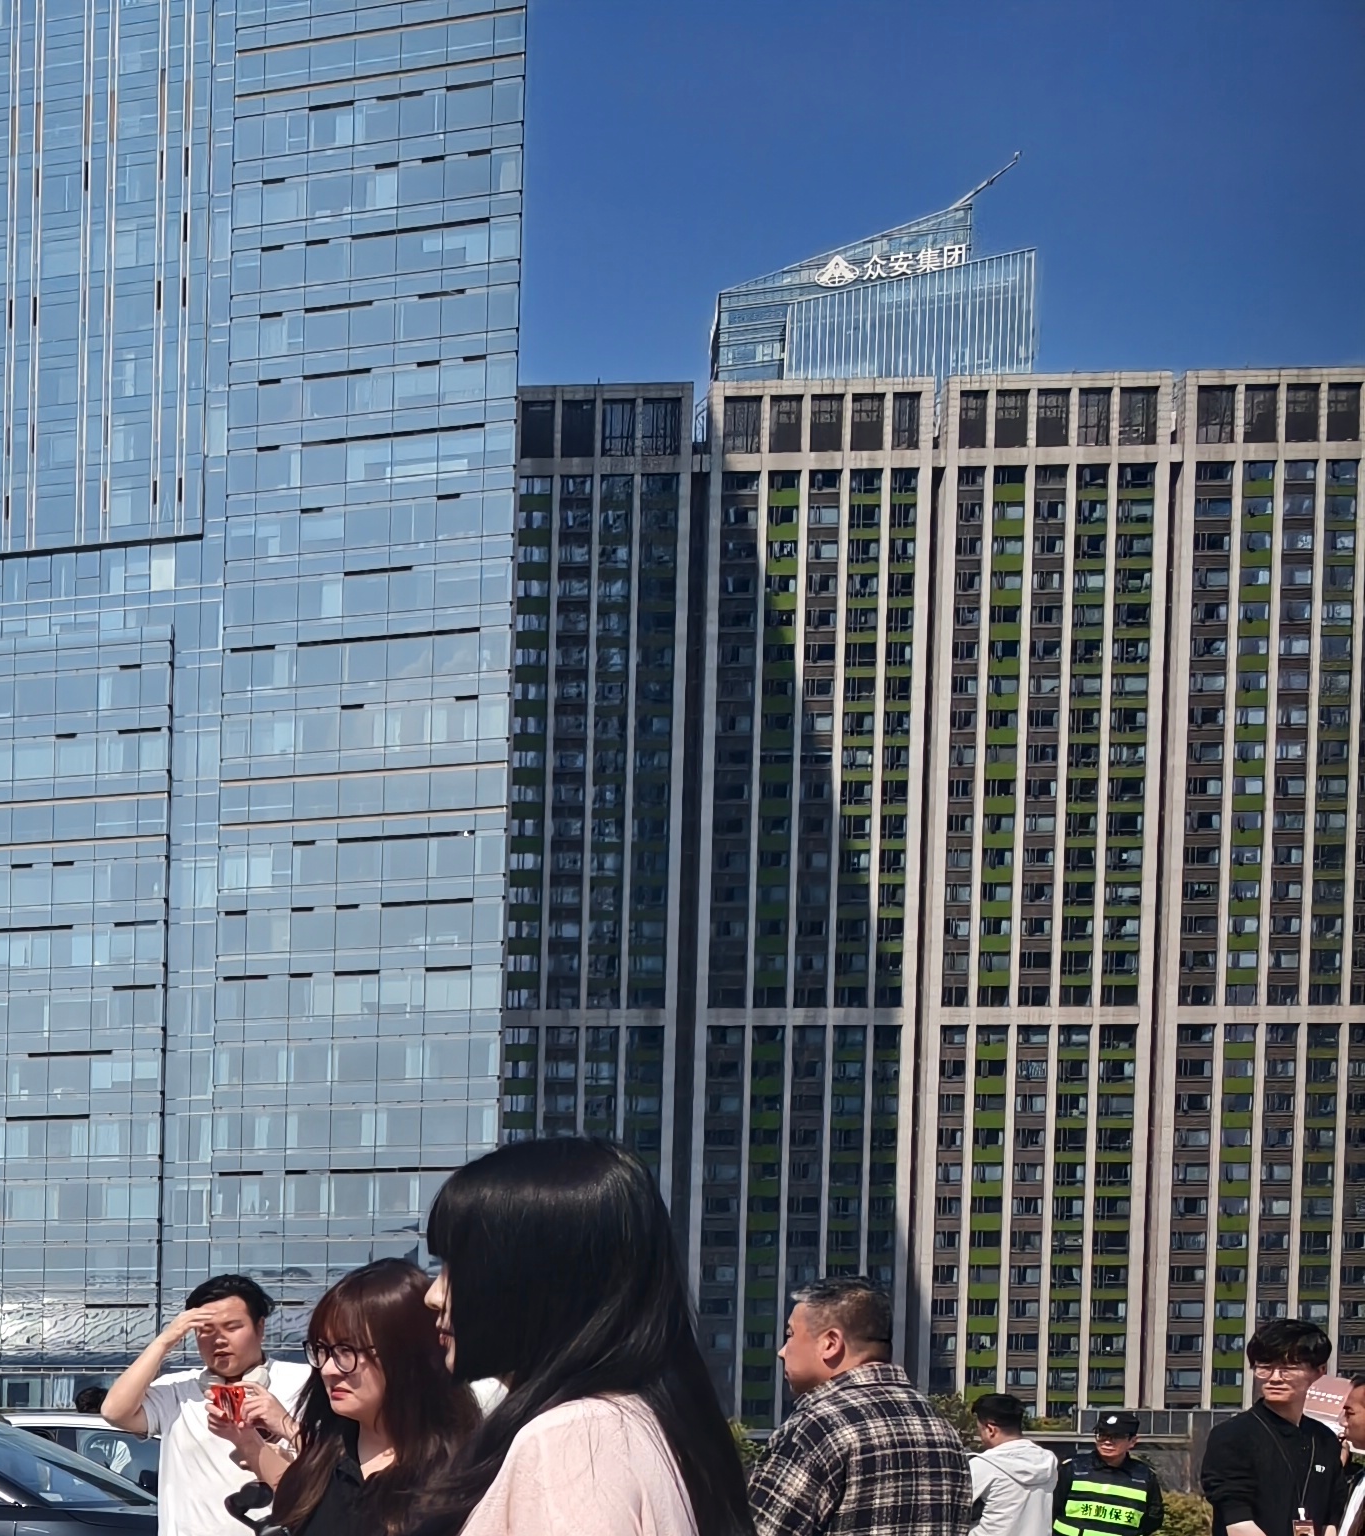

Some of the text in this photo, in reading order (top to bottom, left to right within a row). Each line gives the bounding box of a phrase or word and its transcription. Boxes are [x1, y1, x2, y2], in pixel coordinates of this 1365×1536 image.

[863, 243, 967, 281] 众安集团
[1079, 1502, 1138, 1524] 浙勤保安
